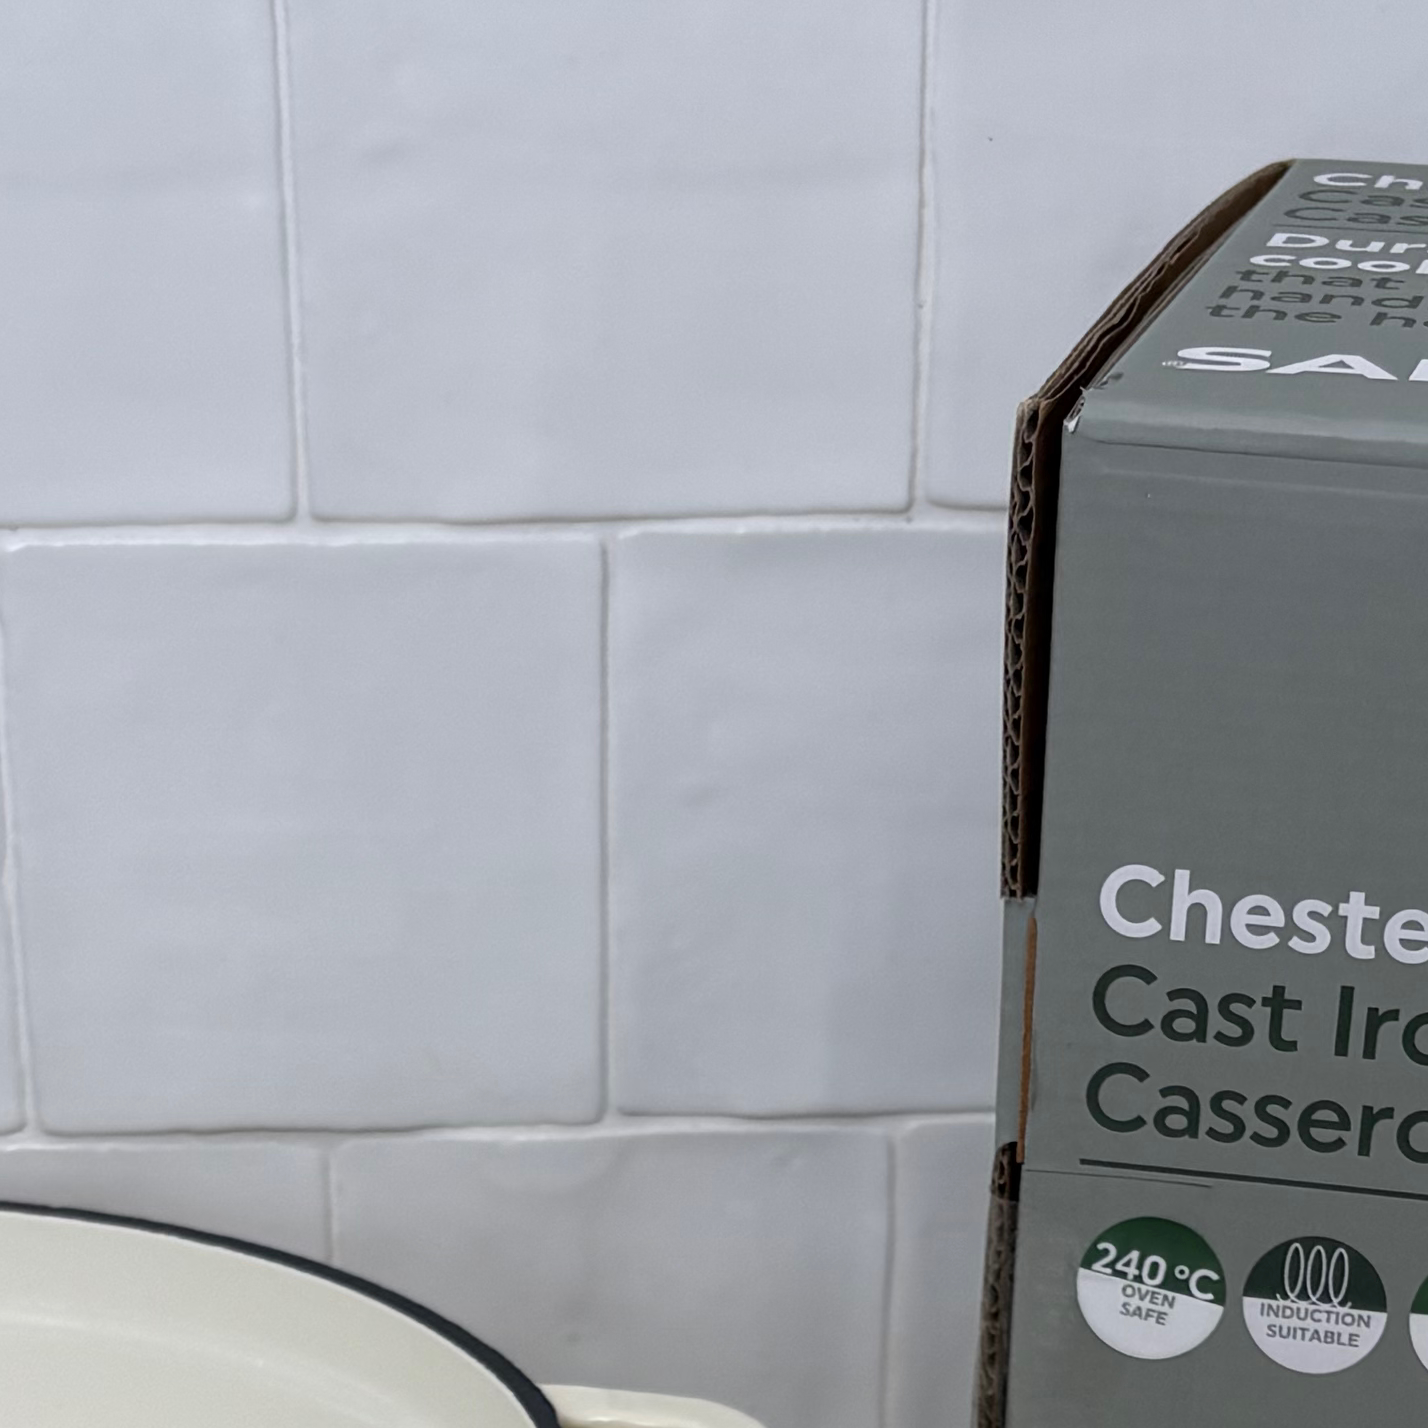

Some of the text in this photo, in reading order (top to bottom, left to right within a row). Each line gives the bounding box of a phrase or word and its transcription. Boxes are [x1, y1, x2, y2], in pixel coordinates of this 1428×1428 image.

[1235, 269, 1406, 290] that
[1206, 304, 1342, 323] the
[1092, 964, 1302, 1053] Cast
[1091, 1242, 1166, 1287] 240
[1121, 1284, 1176, 1309] OVEN
[1119, 1301, 1169, 1326] SAFE
[1260, 1302, 1372, 1328] INDUCTION
[1266, 1324, 1360, 1347] SUITABLE
